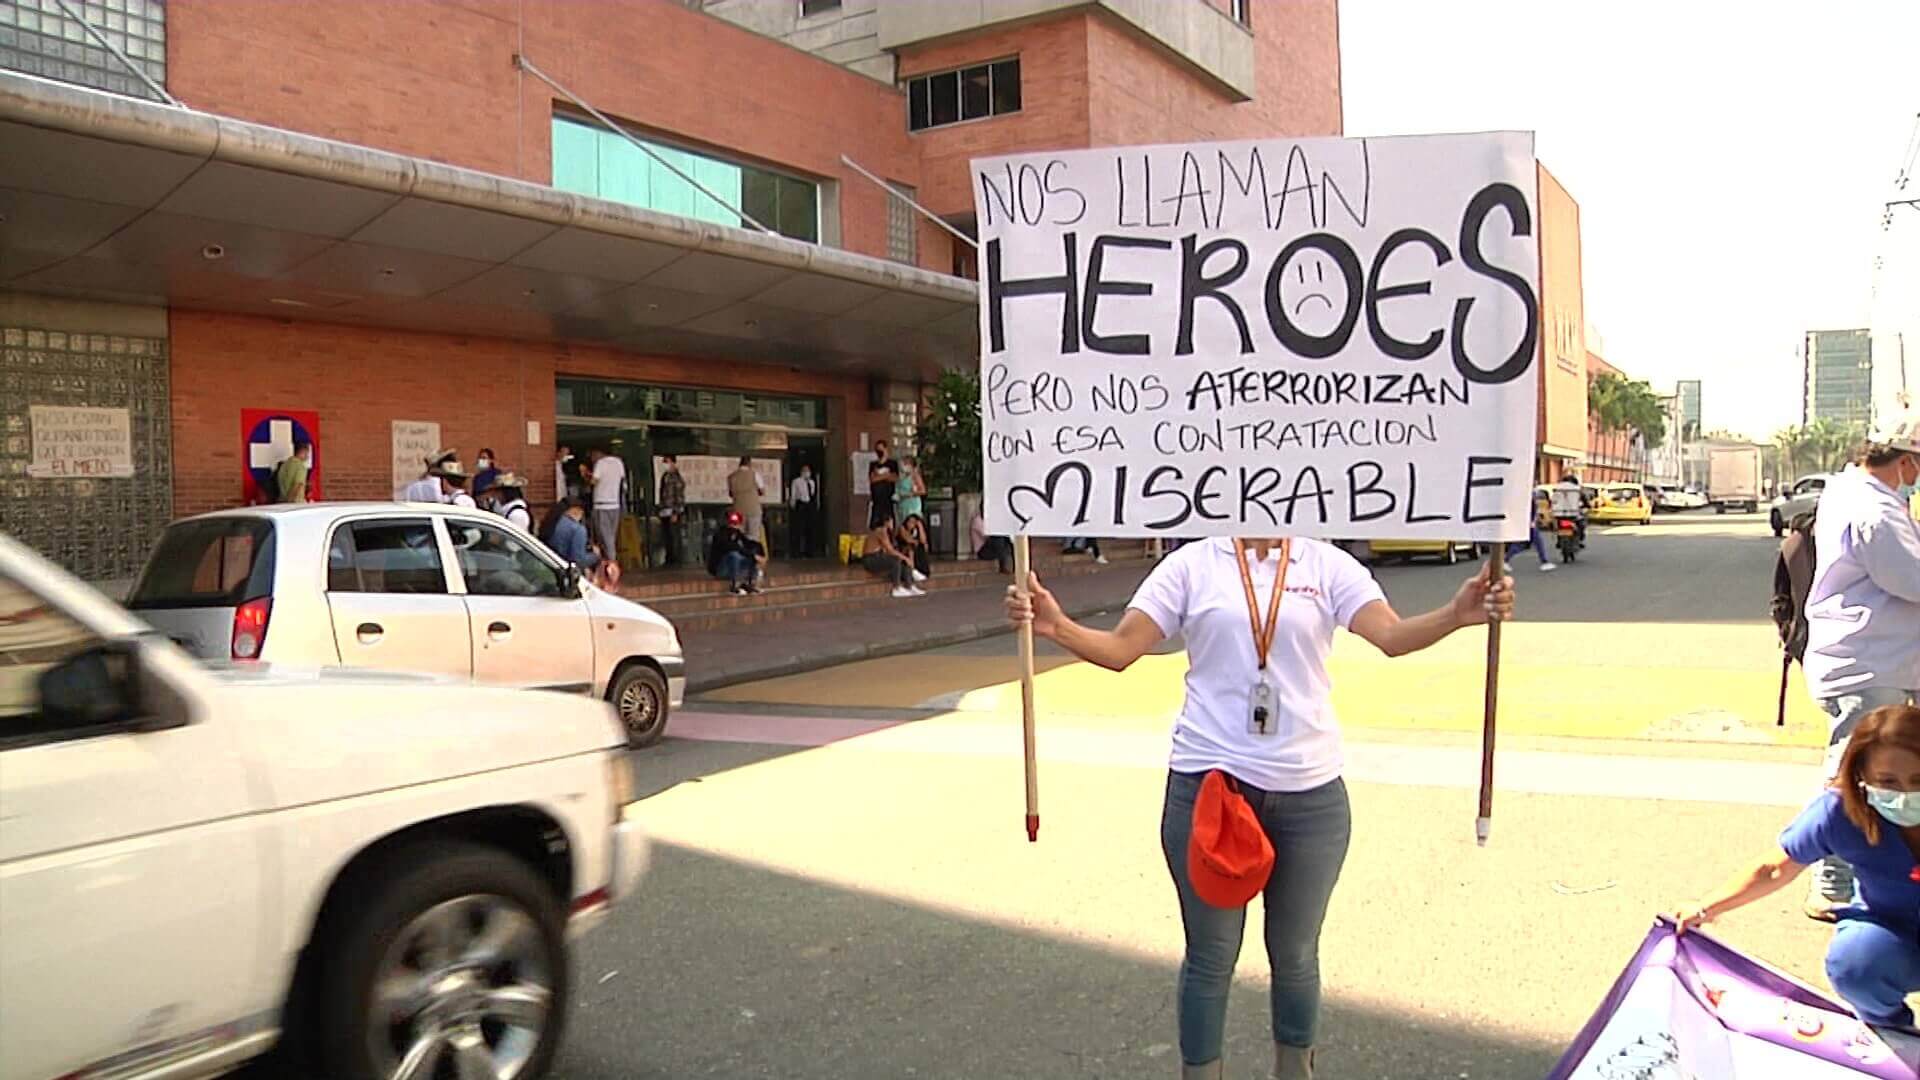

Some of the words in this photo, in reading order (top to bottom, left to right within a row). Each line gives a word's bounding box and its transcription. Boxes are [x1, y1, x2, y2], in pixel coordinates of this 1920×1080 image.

[980, 159, 1087, 227] NOS
[1117, 138, 1370, 230] LLAMAN
[985, 181, 1537, 385] HEROES
[986, 363, 1074, 421] PERO
[1091, 373, 1170, 412] NOS
[1185, 366, 1469, 412] ATERRORIZAN
[986, 429, 1035, 464] CON
[1050, 425, 1126, 453] ESA
[1152, 413, 1439, 455] CONTRATACION
[1006, 455, 1514, 530] MISERABLE
